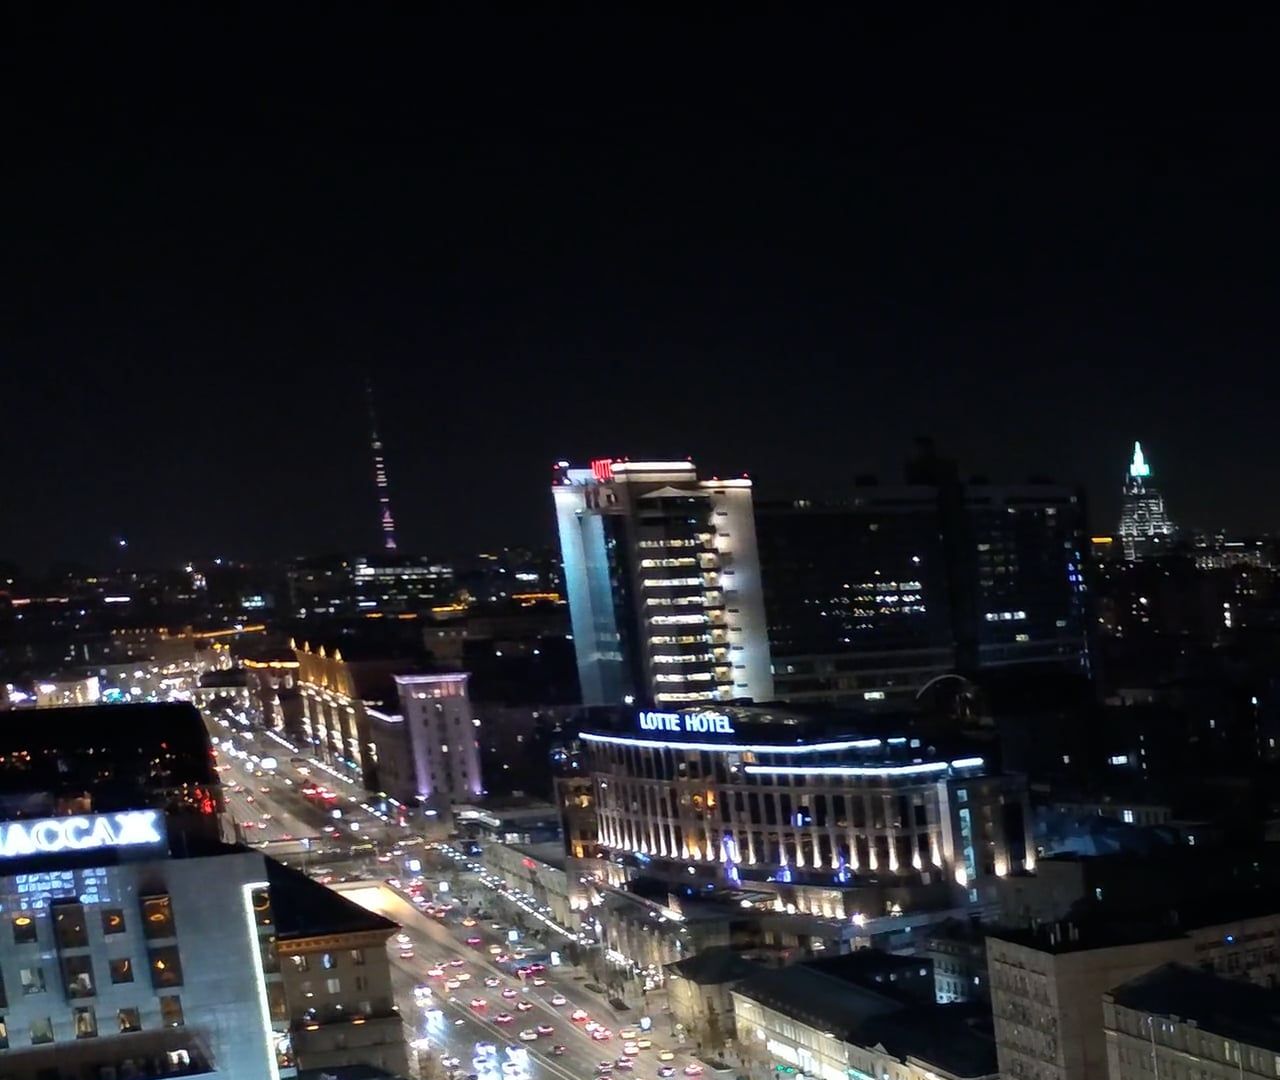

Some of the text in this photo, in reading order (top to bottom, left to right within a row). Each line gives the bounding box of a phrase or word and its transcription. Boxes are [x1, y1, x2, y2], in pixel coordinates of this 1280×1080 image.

[592, 459, 614, 479] LOTTE
[640, 712, 735, 733] LOTTE HOTEL
[0, 812, 160, 856] АССАЖ
